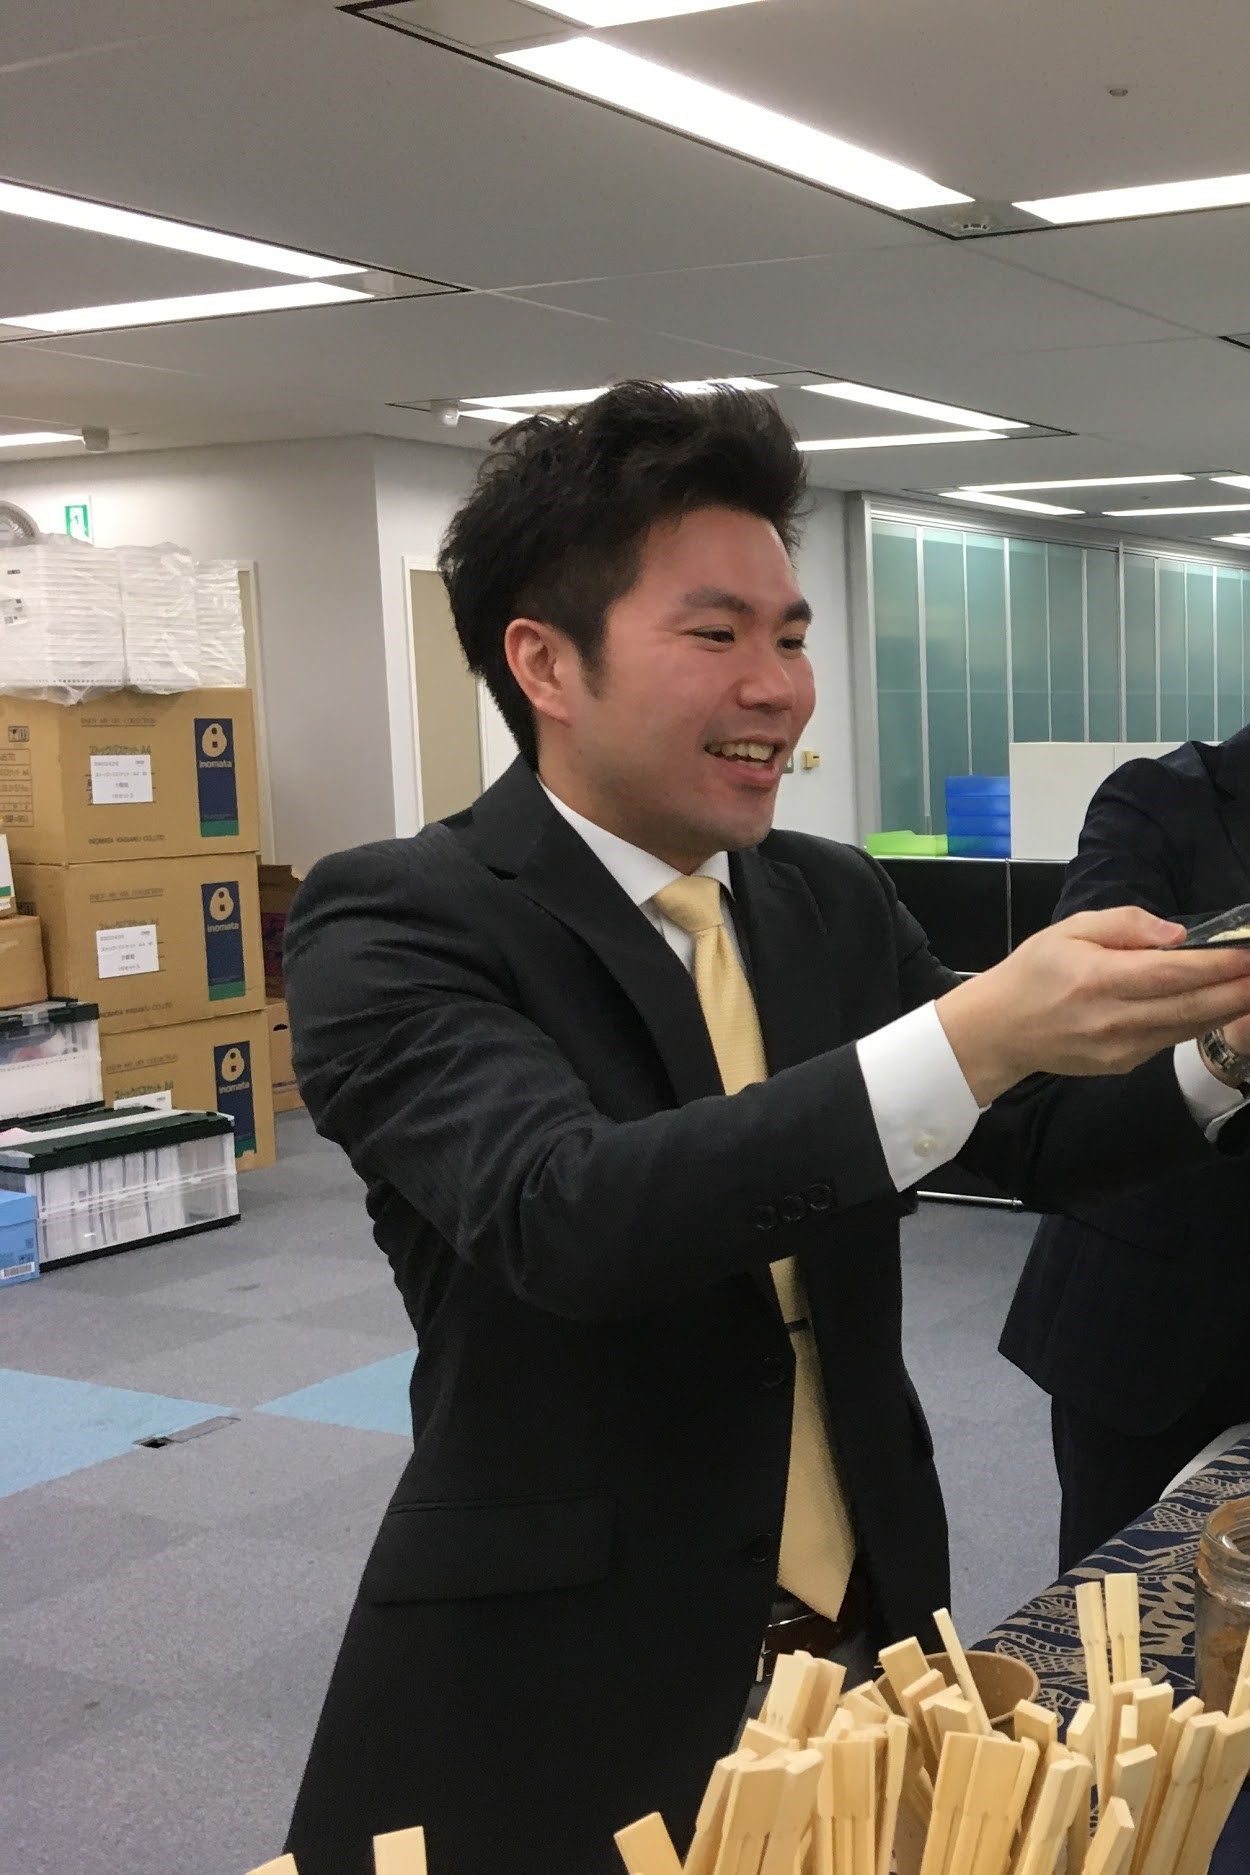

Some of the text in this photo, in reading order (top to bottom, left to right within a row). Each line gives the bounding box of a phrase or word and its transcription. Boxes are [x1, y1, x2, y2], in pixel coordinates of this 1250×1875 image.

[199, 760, 233, 769] inomata
[207, 922, 239, 933] inomata
[219, 1082, 250, 1094] inomata
